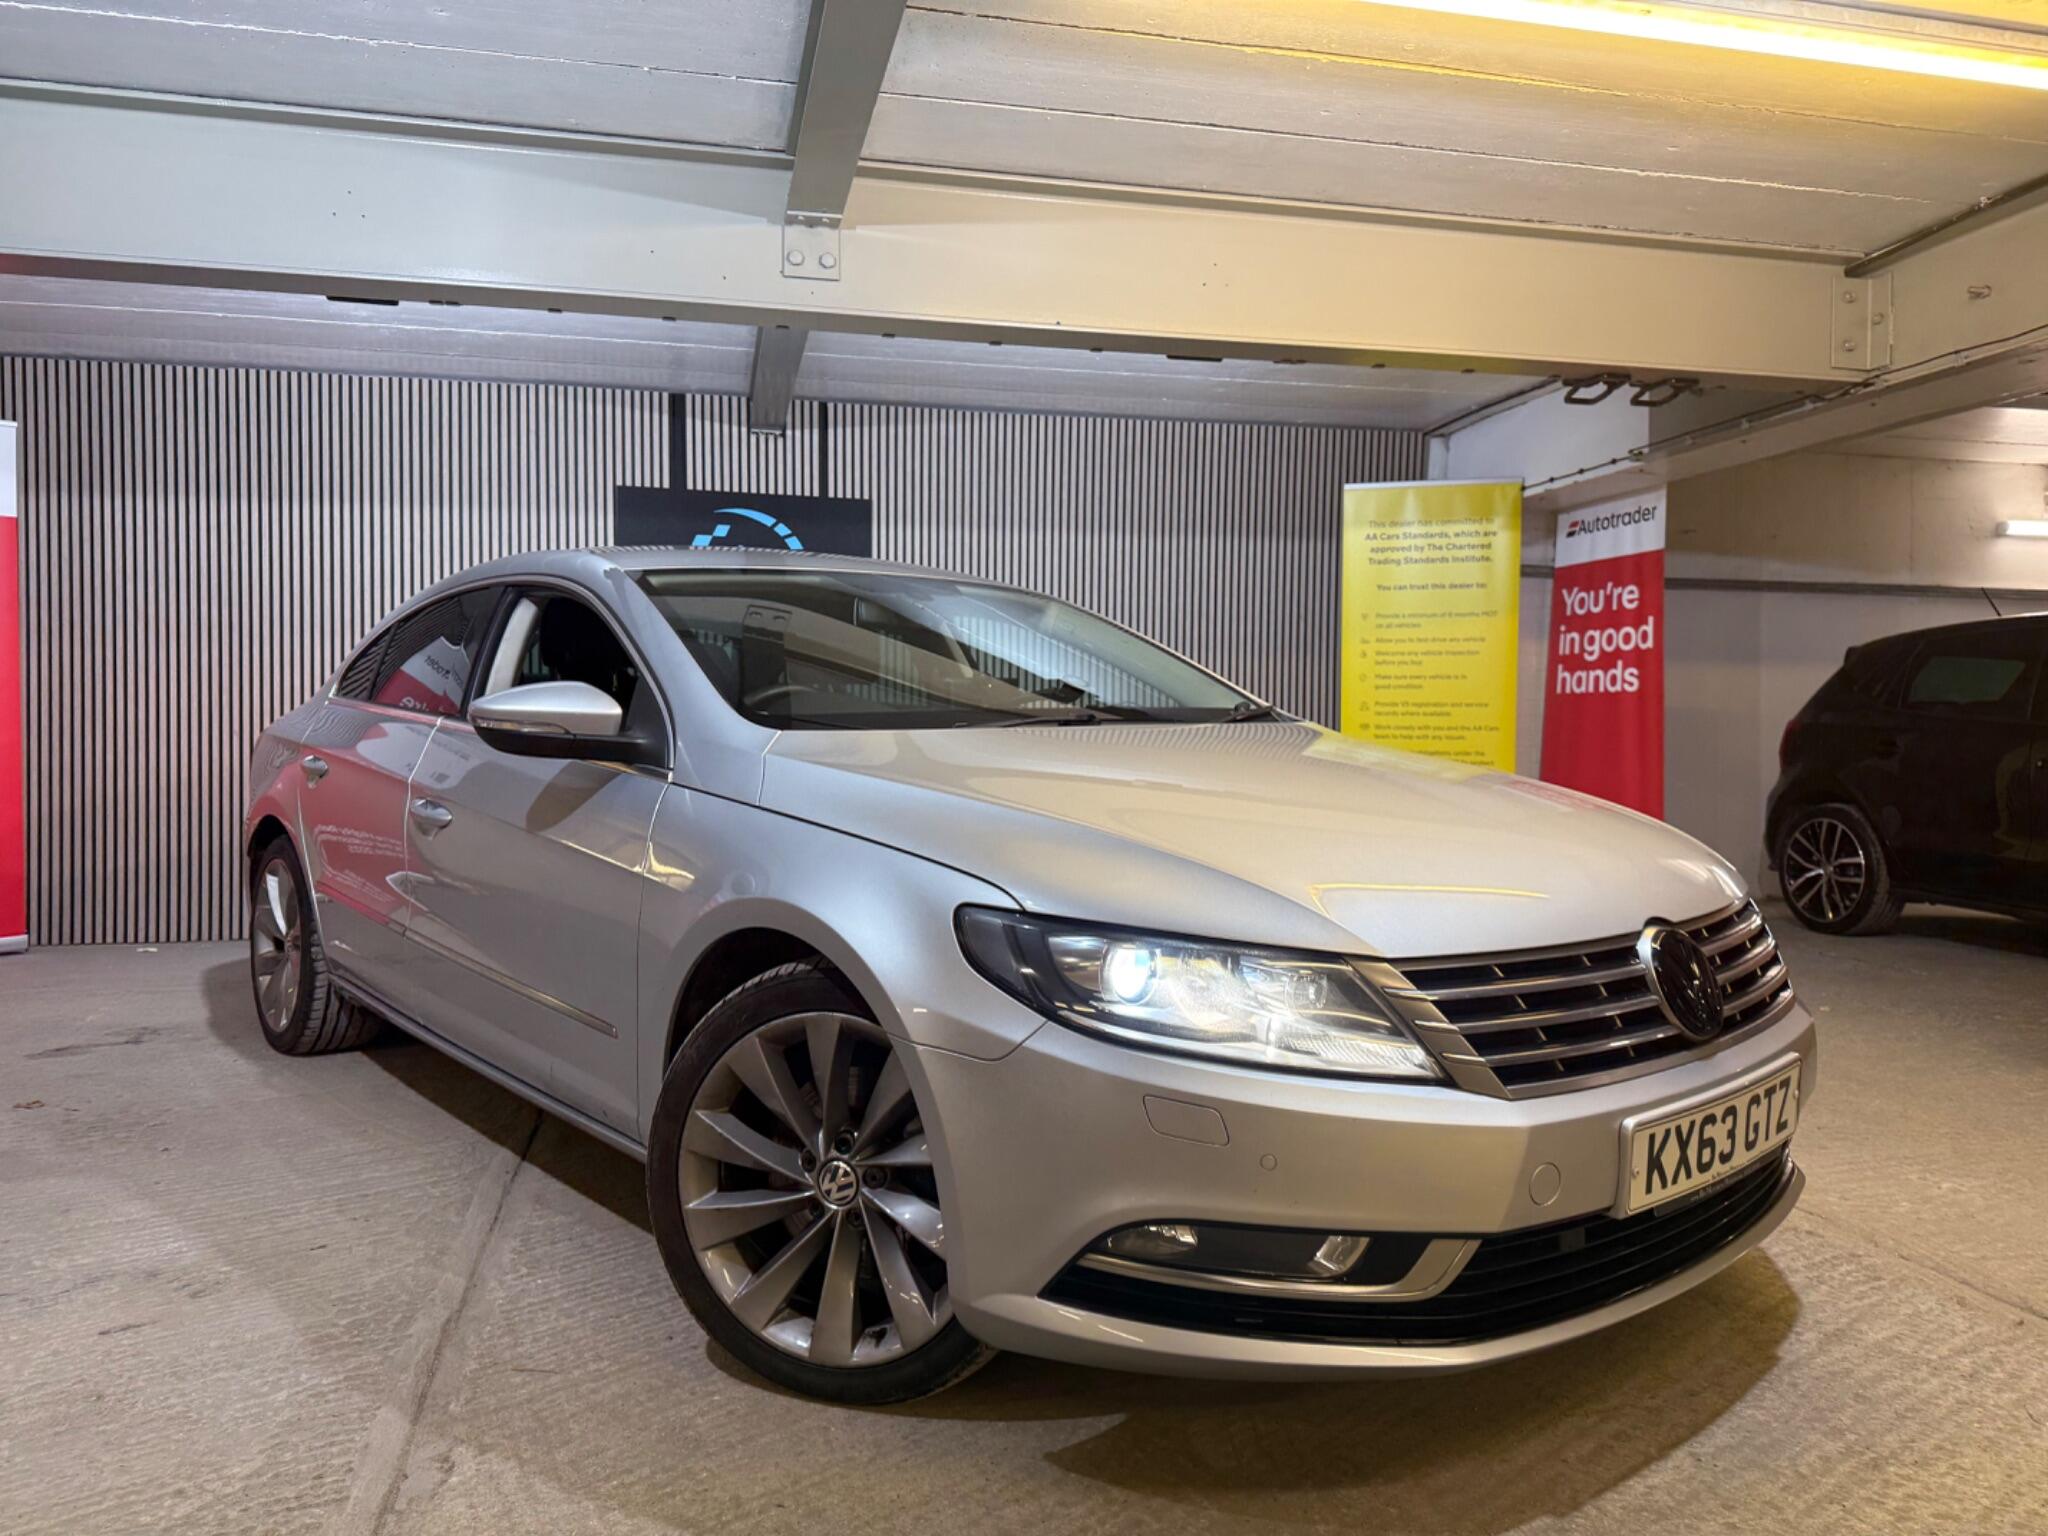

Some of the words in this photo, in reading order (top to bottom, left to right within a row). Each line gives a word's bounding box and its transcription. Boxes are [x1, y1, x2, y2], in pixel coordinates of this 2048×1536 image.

[1364, 532, 1378, 541] AA
[1379, 532, 1400, 541] Cars
[1402, 530, 1451, 540] Standards,
[1454, 529, 1481, 538] which
[1483, 529, 1498, 538] are
[1577, 505, 1658, 536] Autotrader
[1368, 557, 1401, 567] Trading
[1403, 556, 1449, 565] Standards
[1370, 544, 1412, 554] approved
[1413, 543, 1425, 553] by
[1427, 543, 1443, 551] The
[1445, 541, 1492, 551] Chartered
[1562, 582, 1640, 616] You're
[1558, 624, 1580, 656] in
[1583, 616, 1654, 662] good
[1556, 660, 1640, 694] hands
[1645, 1105, 1738, 1196] KX63
[1744, 1075, 1792, 1152] GTZ
